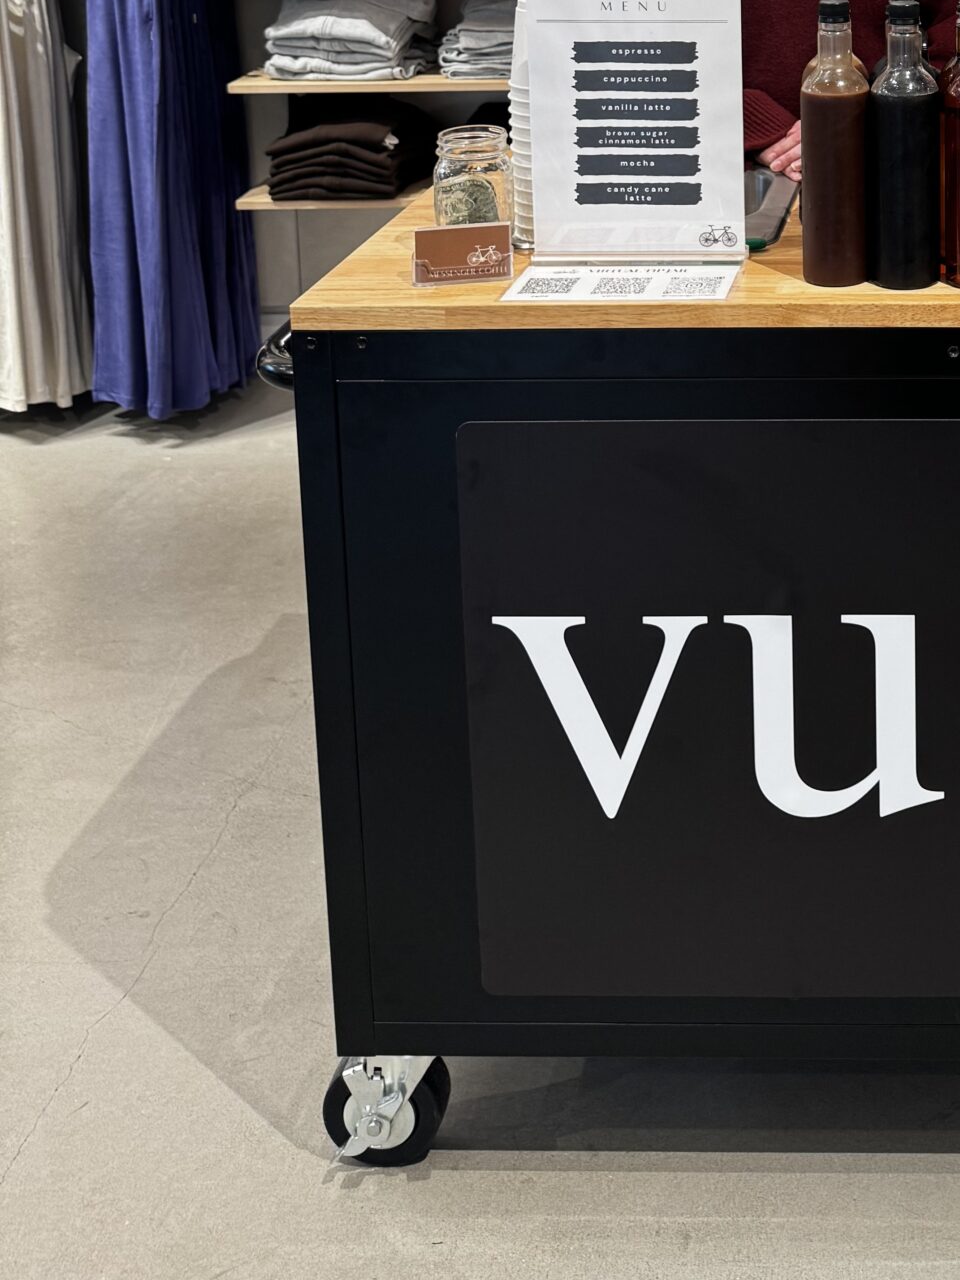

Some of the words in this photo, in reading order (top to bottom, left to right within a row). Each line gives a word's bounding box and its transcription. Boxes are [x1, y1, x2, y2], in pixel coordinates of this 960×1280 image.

[600, 0, 667, 12] MENU
[611, 48, 662, 56] espresso
[603, 75, 668, 84] cappuccino
[601, 103, 639, 111] vanilla
[643, 103, 671, 111] latte
[605, 129, 636, 137] brown
[640, 130, 668, 139] sugar
[598, 137, 647, 145] cinnamon
[650, 137, 676, 145] latte
[620, 159, 655, 167] mocha
[606, 185, 640, 195] candy
[625, 194, 652, 202] latte
